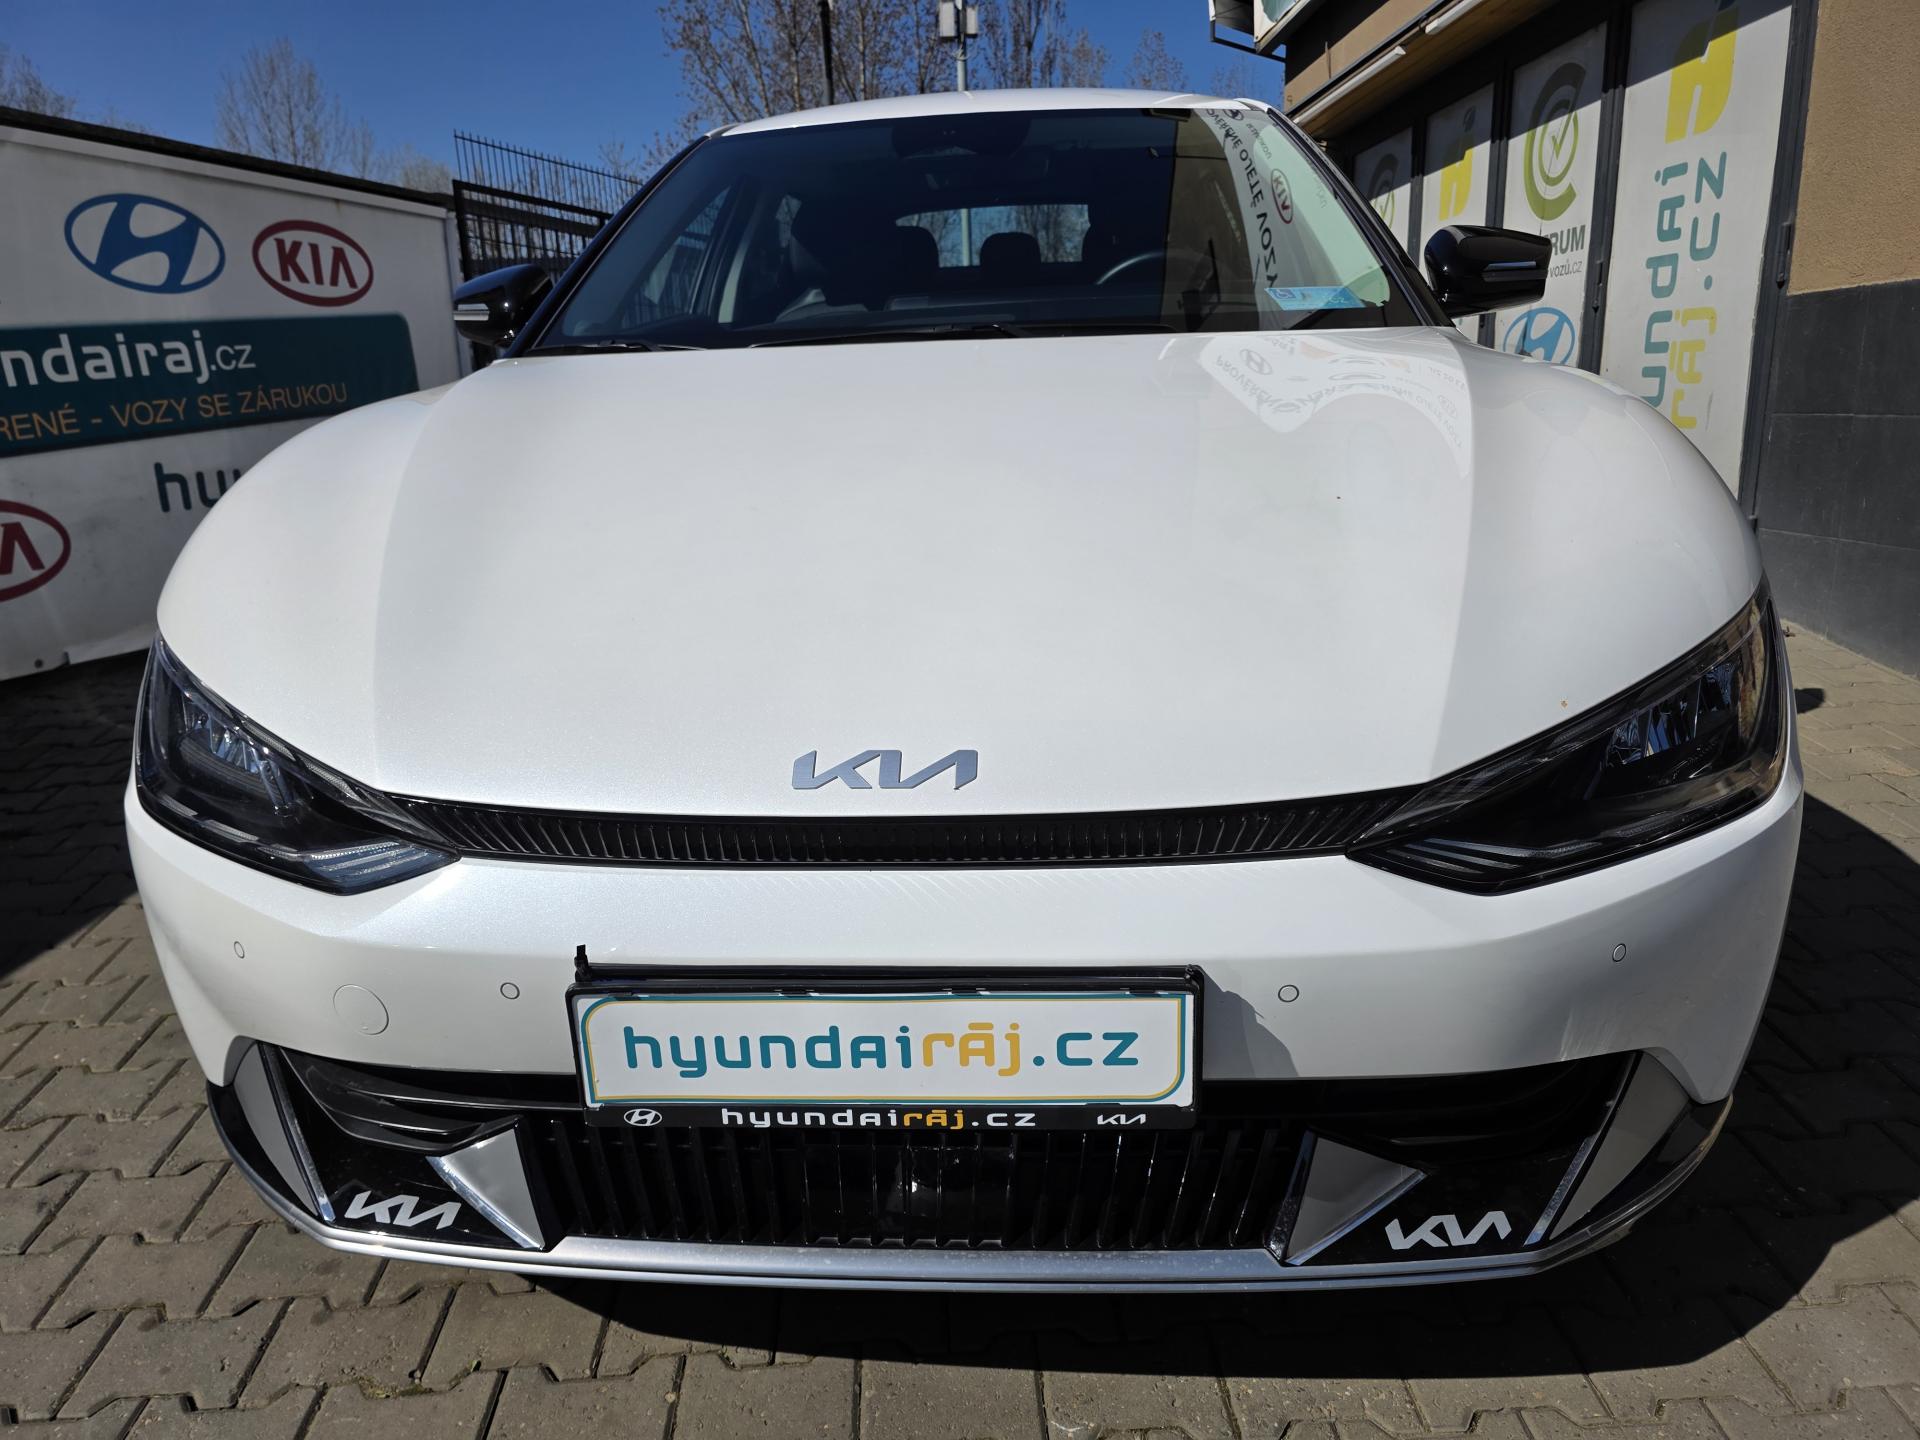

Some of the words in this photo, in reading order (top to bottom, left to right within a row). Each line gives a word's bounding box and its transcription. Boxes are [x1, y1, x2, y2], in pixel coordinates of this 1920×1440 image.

[274, 237, 359, 289] KIA
[1543, 224, 1586, 256] RUM
[110, 397, 188, 428] VOZY
[197, 393, 232, 418] SE
[236, 382, 347, 414] ZÁRUKOU
